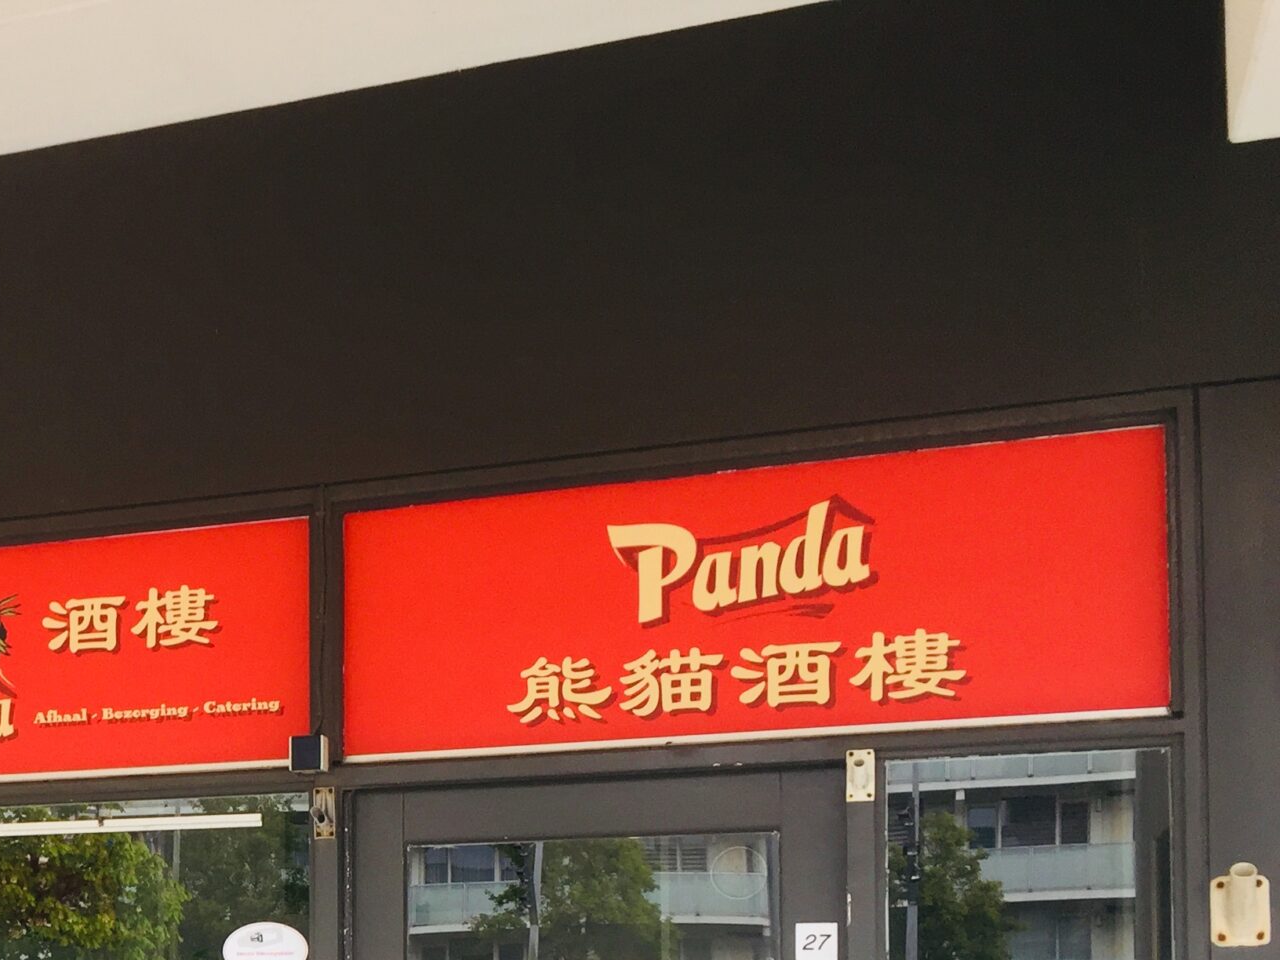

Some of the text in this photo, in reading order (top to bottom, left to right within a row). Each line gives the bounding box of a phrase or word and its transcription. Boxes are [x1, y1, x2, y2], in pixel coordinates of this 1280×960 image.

[607, 501, 870, 623] Panda
[43, 585, 217, 652] 酒樓
[507, 629, 967, 722] 熊貓酒樓
[34, 708, 87, 724] Afhaal
[102, 703, 188, 720] Bezorging
[203, 697, 280, 714] Catering
[802, 934, 832, 951] 27
